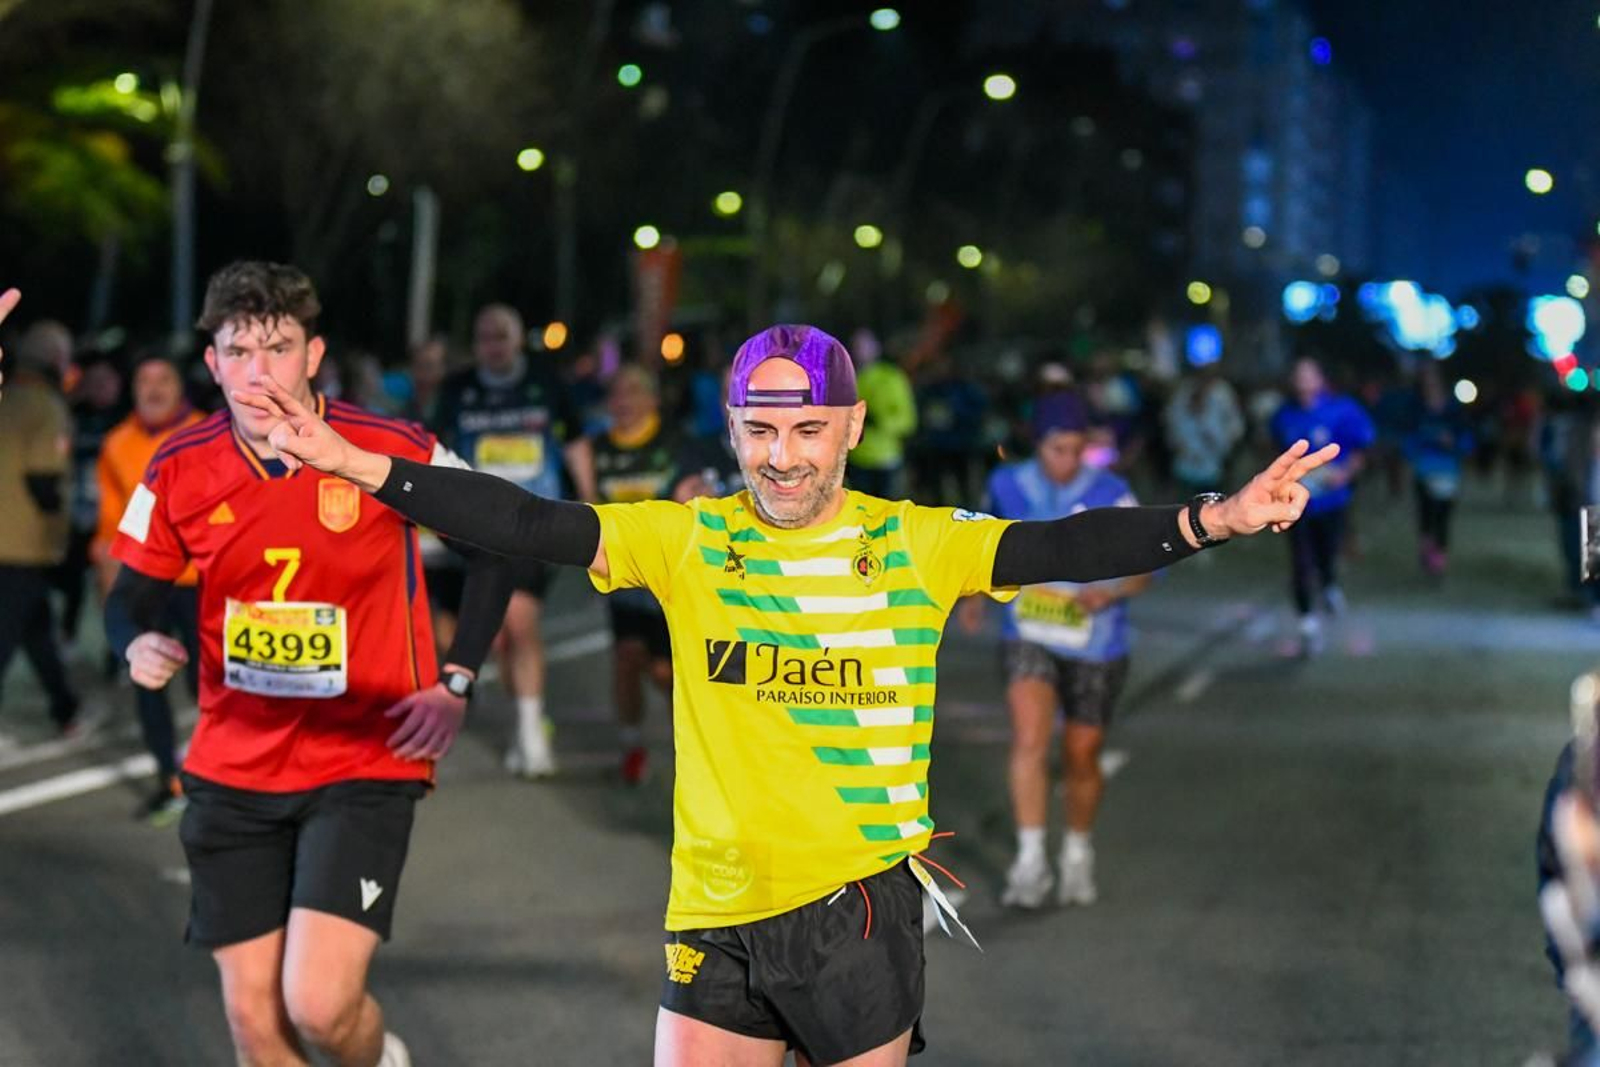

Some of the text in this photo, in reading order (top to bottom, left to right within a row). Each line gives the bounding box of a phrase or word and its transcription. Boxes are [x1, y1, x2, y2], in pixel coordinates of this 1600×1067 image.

[264, 547, 301, 602] 7
[234, 627, 332, 662] 4399
[756, 643, 863, 687] Jaén
[756, 687, 898, 705] PARAÍSO INTERIOR
